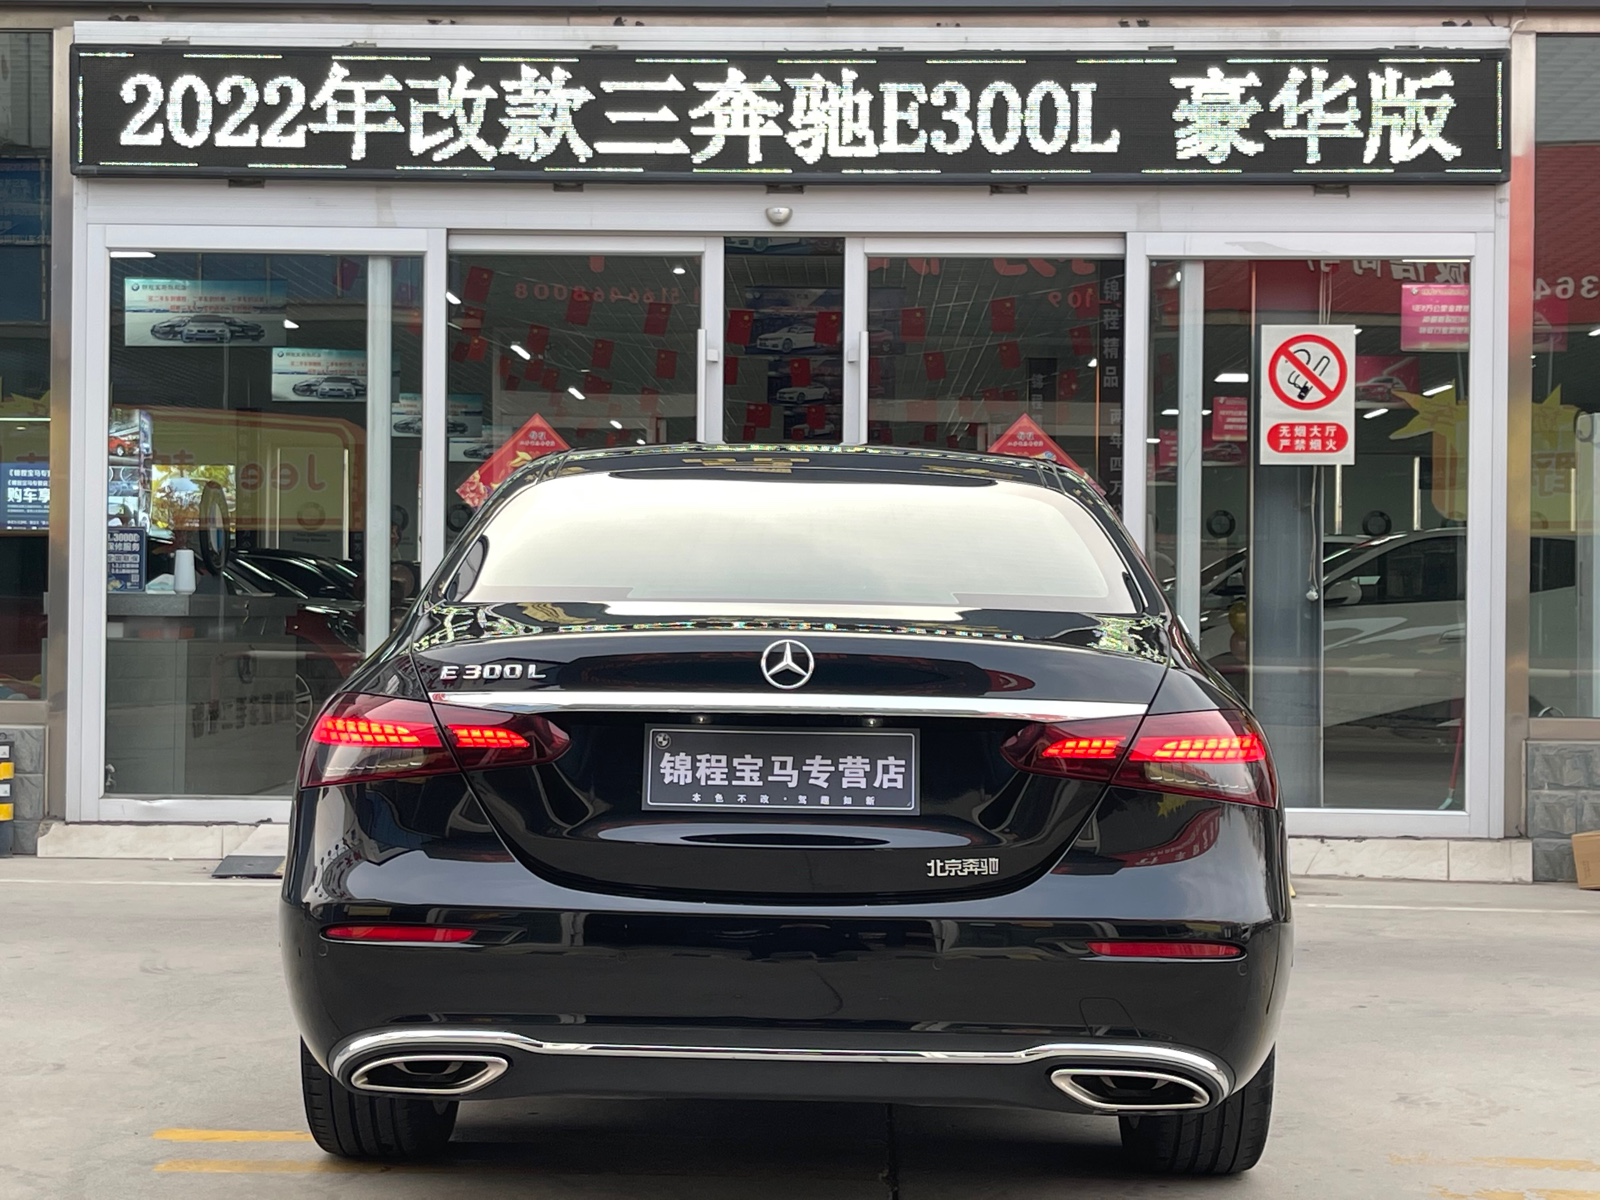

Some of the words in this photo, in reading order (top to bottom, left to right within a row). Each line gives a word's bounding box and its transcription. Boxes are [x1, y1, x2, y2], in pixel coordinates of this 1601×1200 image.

[119, 63, 1120, 165] 2022年改款三奔驰E300L
[1170, 67, 1463, 165] 豪华版
[1279, 425, 1337, 437] 无烟大厅
[1279, 438, 1337, 451] 严禁烟火
[659, 752, 906, 789] 锦程宝马专营店
[926, 857, 999, 877] 北京奔驰
